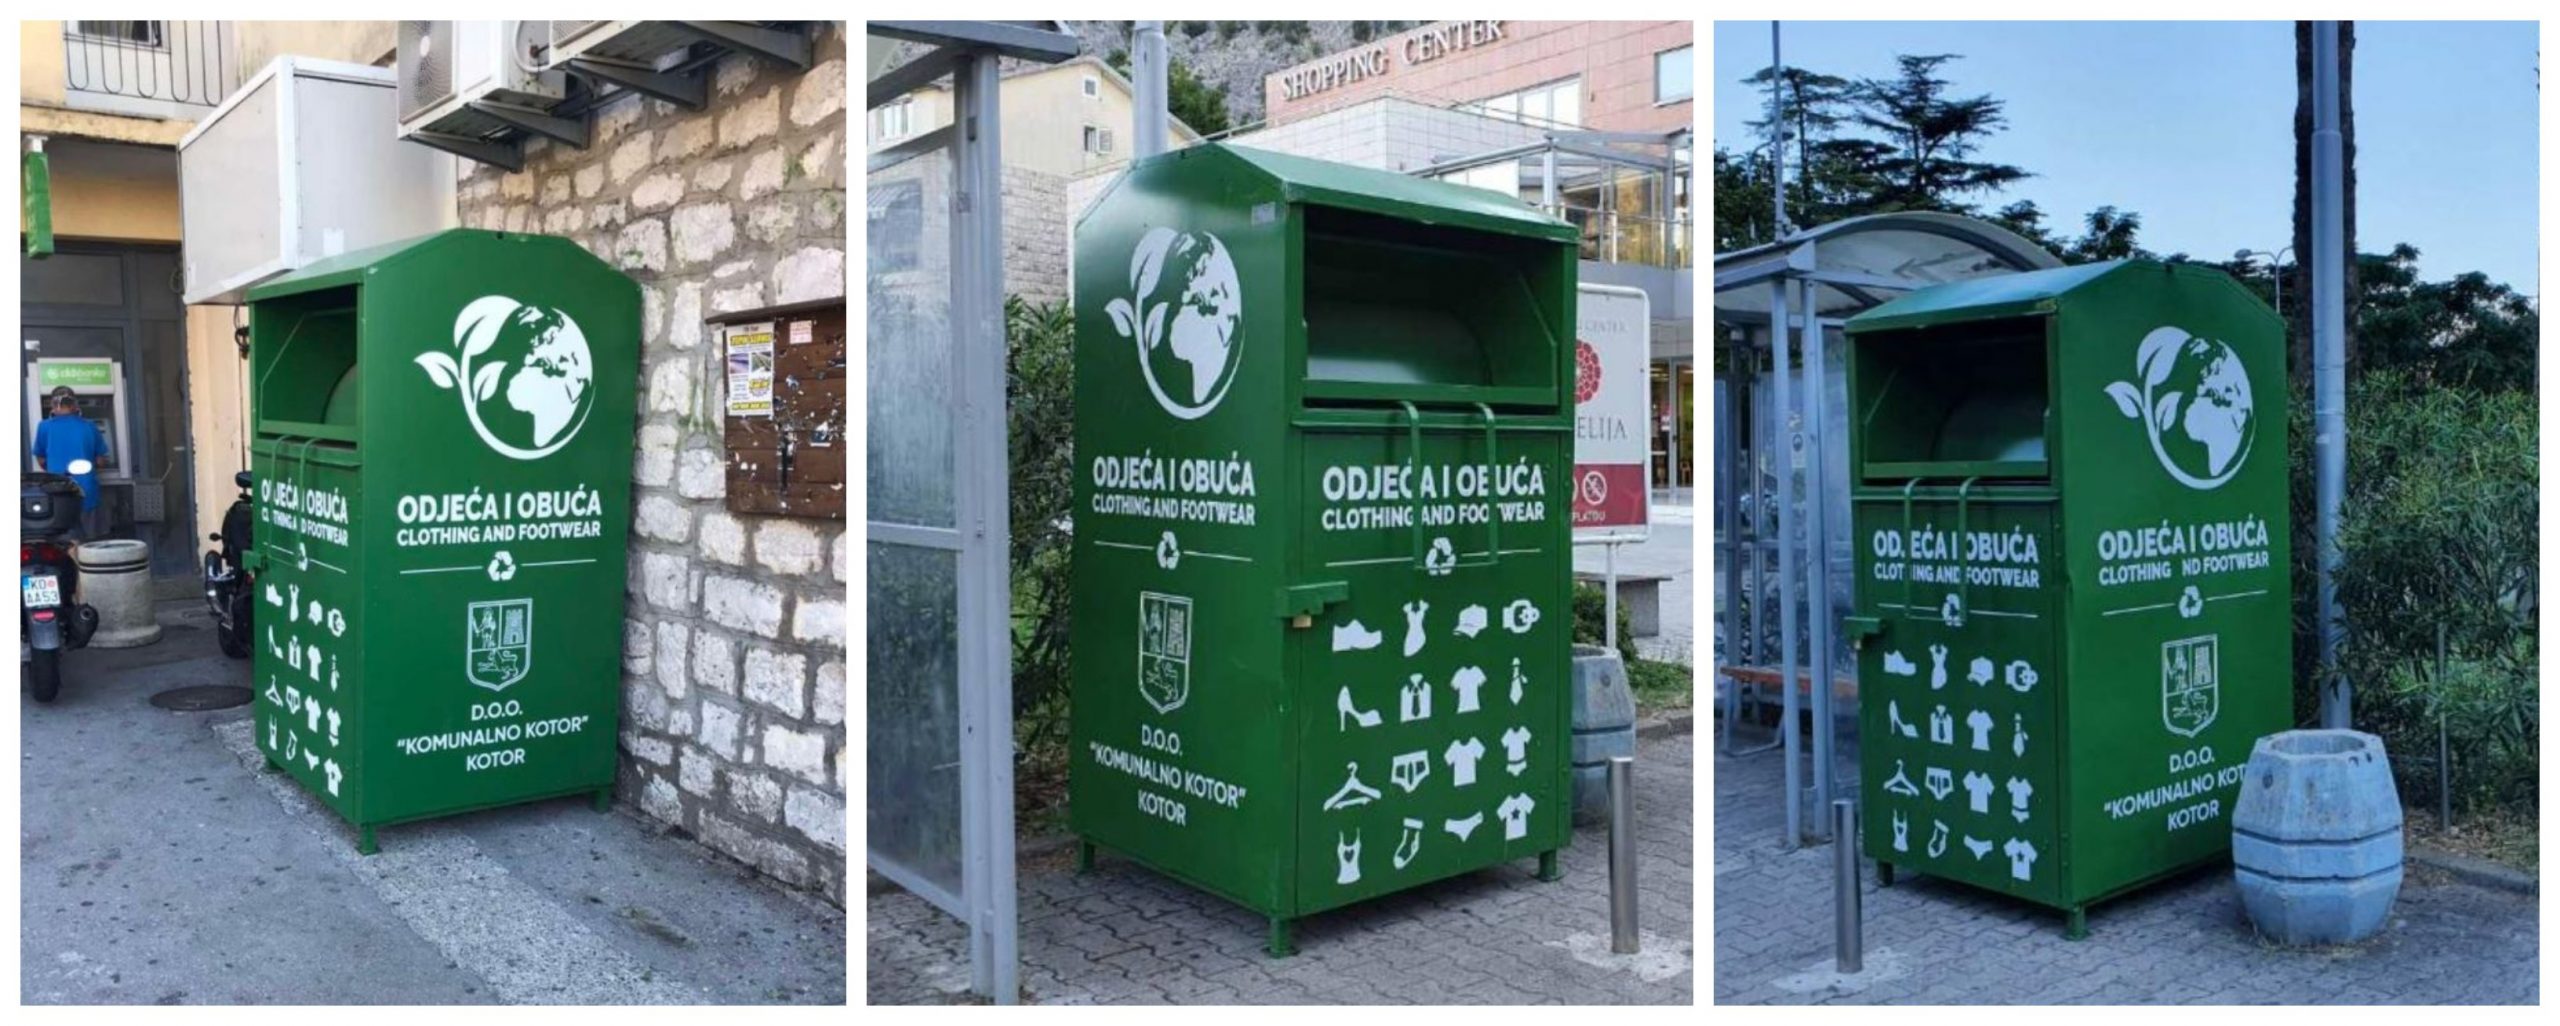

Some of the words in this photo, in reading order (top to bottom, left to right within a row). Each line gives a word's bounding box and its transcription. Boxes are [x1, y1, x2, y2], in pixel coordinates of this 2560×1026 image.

[1282, 48, 1387, 100] SHOPPING
[1402, 20, 1505, 65] CENTER
[1577, 416, 1628, 442] ELIJA
[1093, 447, 1166, 492] ODJEĆA
[1169, 458, 1176, 492] I
[1179, 450, 1256, 496] OBUĆA
[1322, 456, 1437, 501] ODJEĆA
[1443, 465, 1450, 498] I
[261, 477, 298, 510] OJEĆA
[306, 487, 349, 525] OBUĆA
[397, 486, 499, 524] ODJEĆA
[504, 492, 512, 520] I
[516, 483, 602, 518] OBUĆA
[1091, 493, 1150, 517] CLOTHING
[1152, 498, 1179, 519] AND
[1181, 500, 1256, 526] FOOTWEAR
[1321, 506, 1414, 531] CLOTHING
[1421, 504, 1455, 526] AND
[261, 507, 292, 530] CLTHING
[293, 515, 306, 534] AD
[307, 519, 349, 548] FOOTWEAR
[396, 525, 480, 546] CLOTHING
[482, 525, 516, 542] AND
[518, 521, 601, 540] FOOTWEAR
[2098, 519, 2186, 560] ODJEĆA
[2189, 525, 2196, 552] I
[2200, 513, 2268, 550] OBUĆA
[1951, 531, 1958, 560] I
[1874, 562, 1934, 583] CLOTING
[1966, 567, 2040, 588] FOOTWEAR
[2099, 561, 2172, 586] CLOTHING
[2182, 558, 2200, 576] ND
[2203, 551, 2270, 574] FOOTWEAR
[471, 699, 524, 721] D.O.O.
[1141, 723, 1183, 756] D.O.O.
[466, 748, 526, 772] KOTOR
[2169, 746, 2215, 774] D.O.O.
[2217, 763, 2248, 788] KOT
[1137, 789, 1187, 826] KOTOR
[2167, 799, 2220, 832] KOTOR
